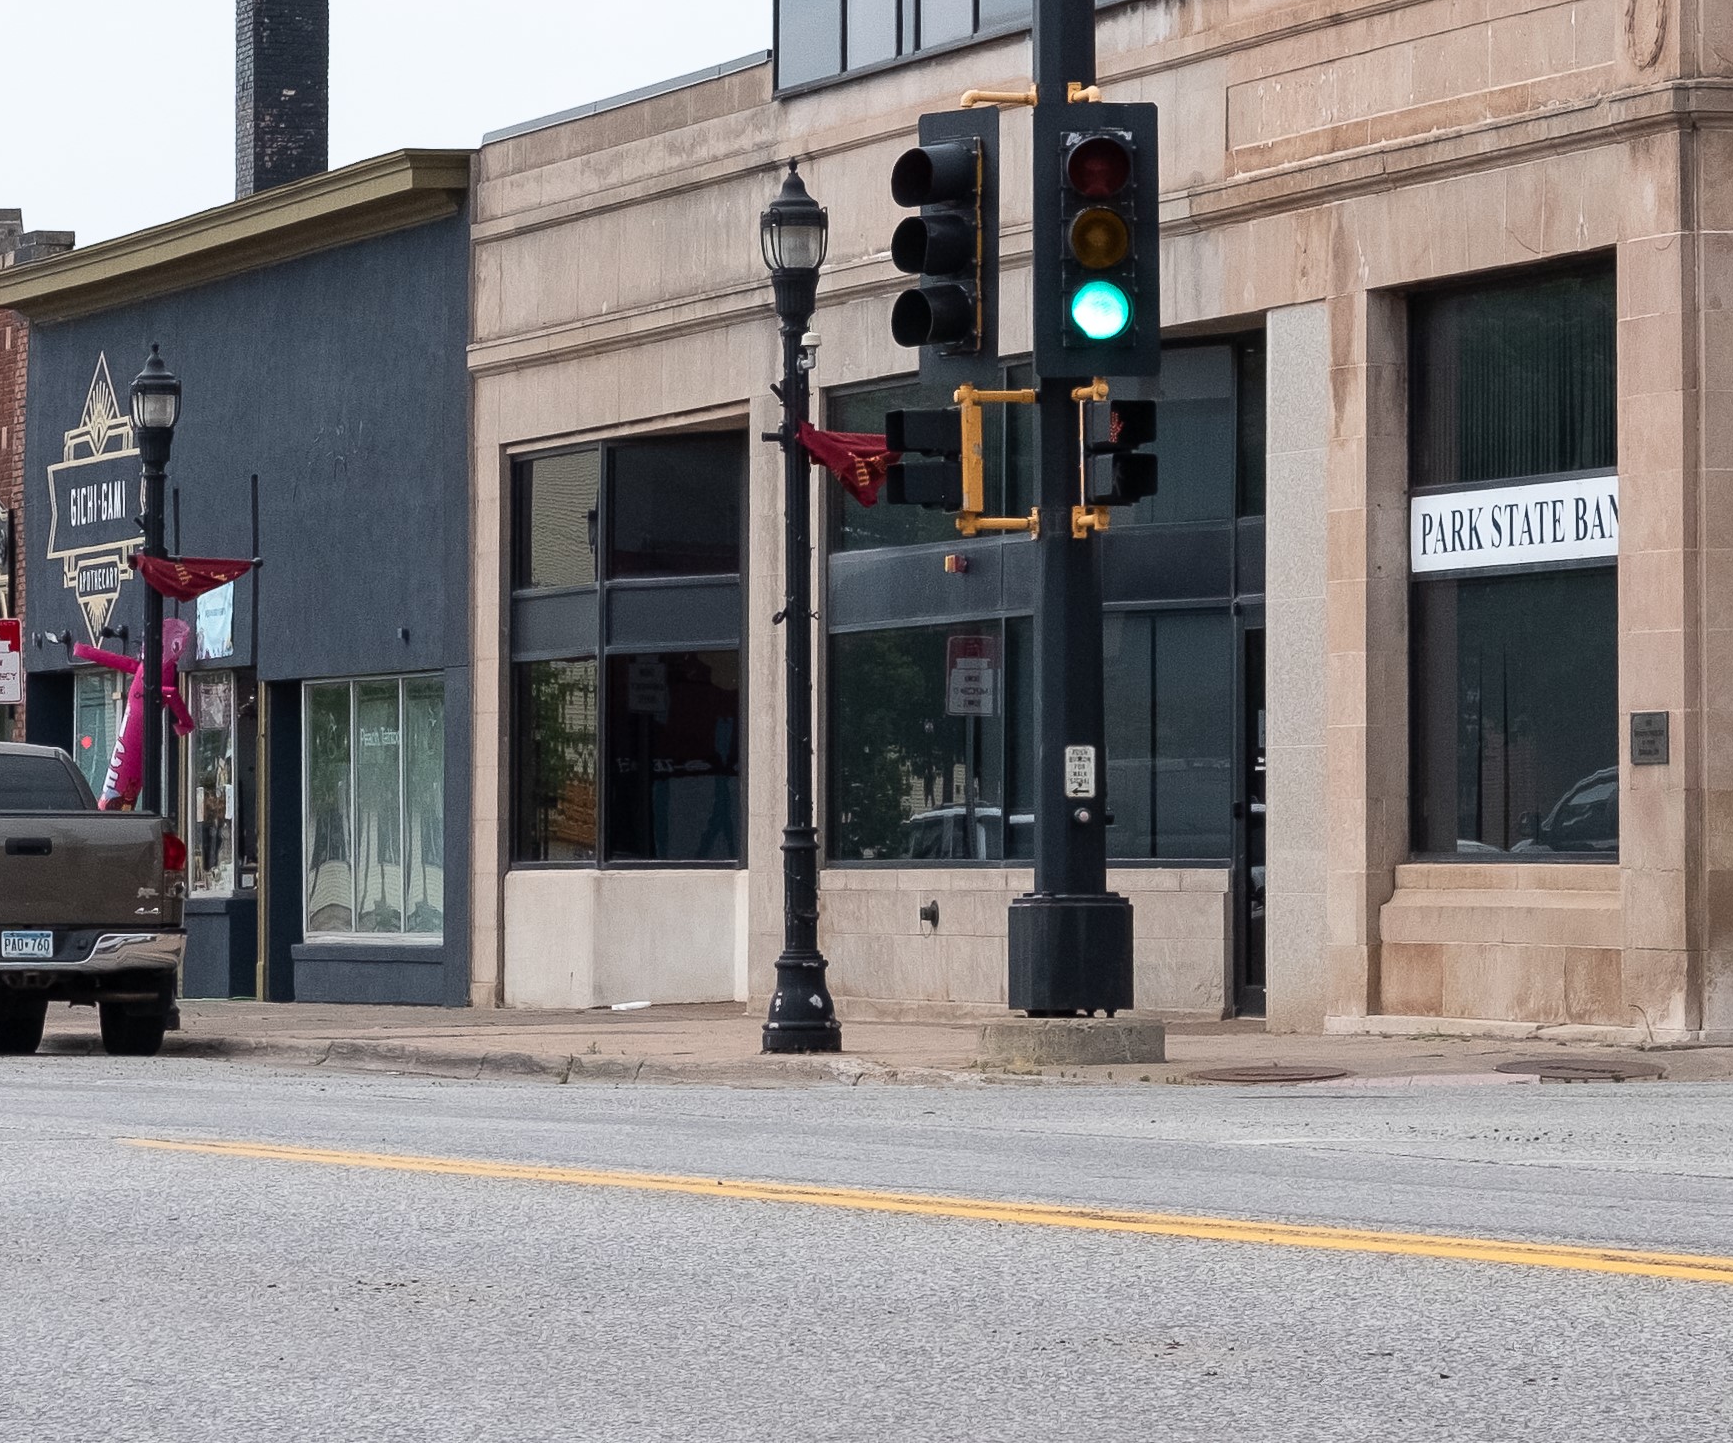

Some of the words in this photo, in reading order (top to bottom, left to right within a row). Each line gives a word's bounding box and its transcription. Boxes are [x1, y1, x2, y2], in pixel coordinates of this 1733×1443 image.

[1421, 507, 1484, 555] PARK
[1491, 500, 1565, 548] STATE
[1573, 495, 1619, 541] BAN
